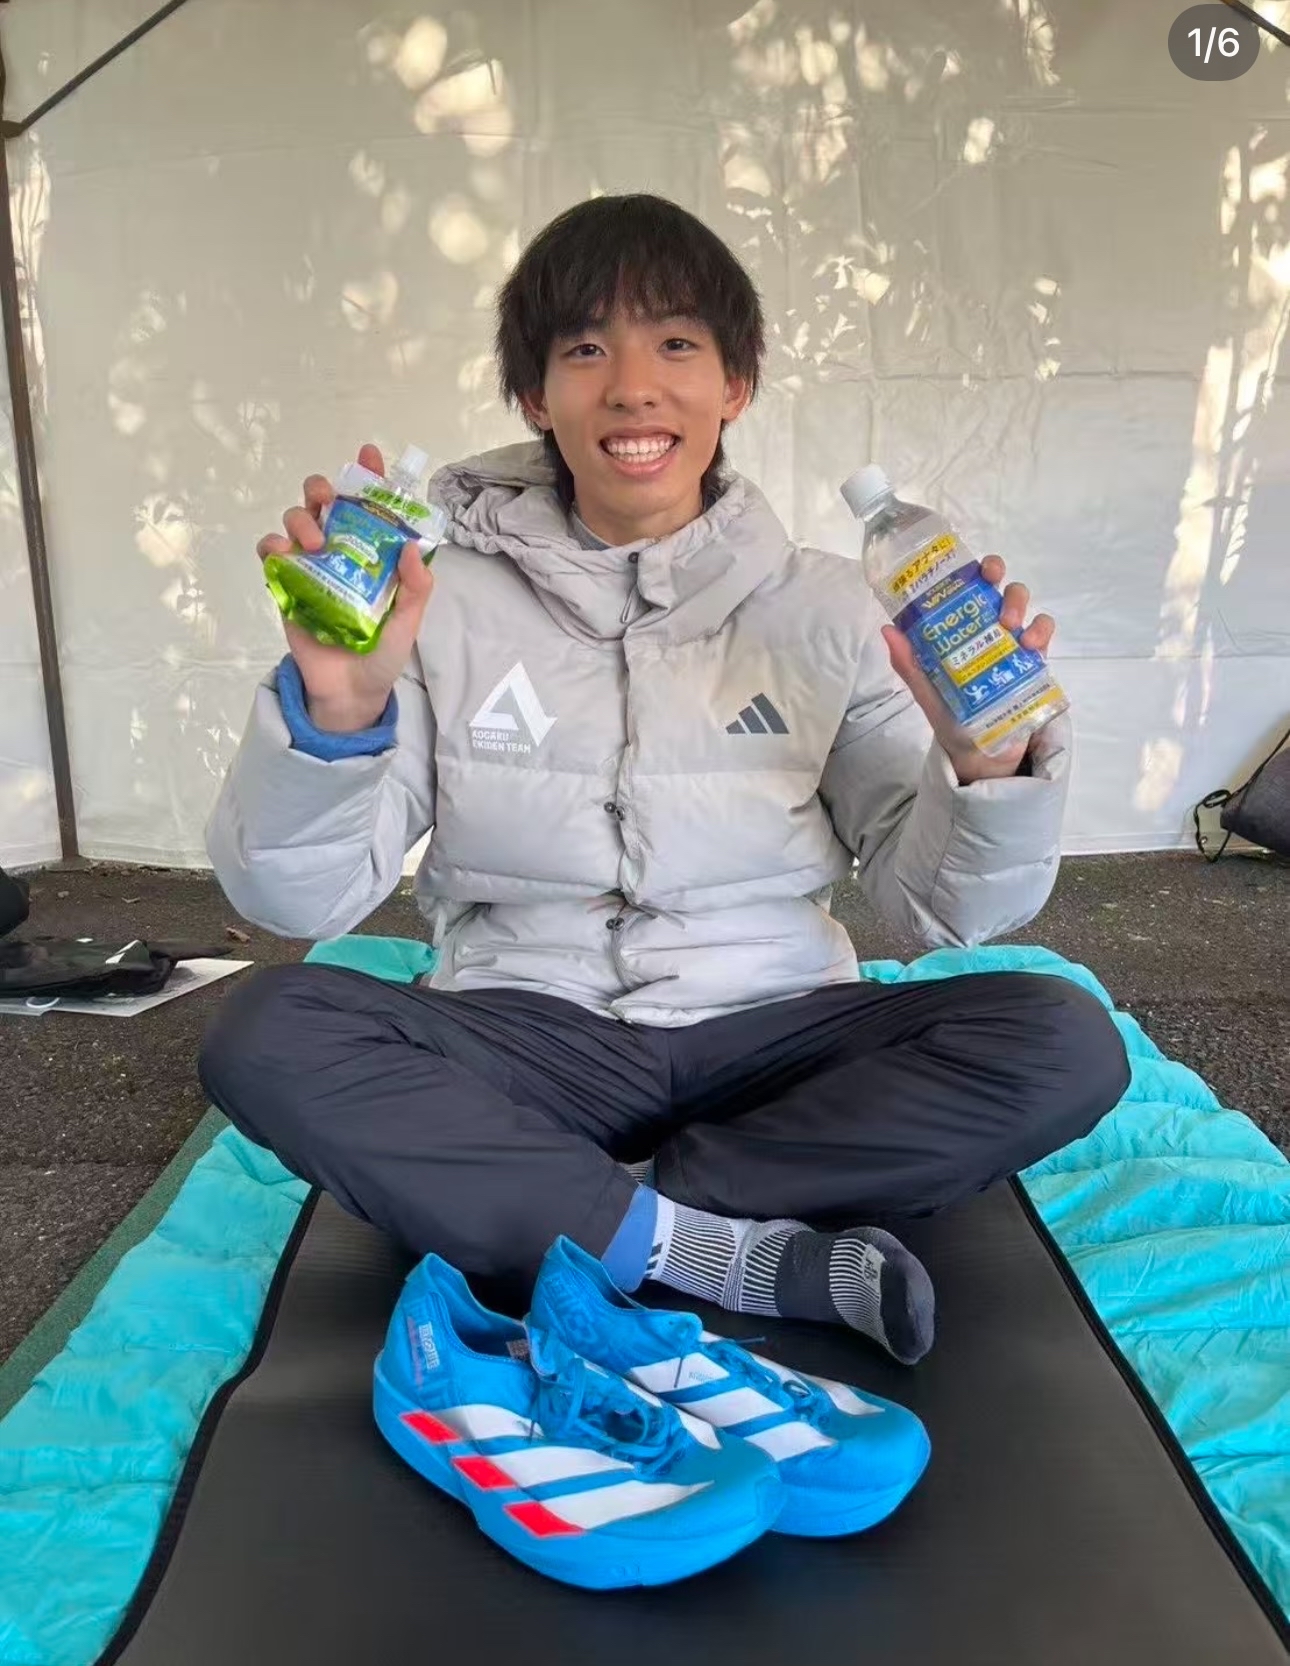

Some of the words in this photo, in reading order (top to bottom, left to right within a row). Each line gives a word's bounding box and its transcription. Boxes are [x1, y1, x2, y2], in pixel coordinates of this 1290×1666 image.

[922, 593, 987, 641] Energic
[932, 616, 983, 658] Water
[505, 742, 531, 754] TEAM
